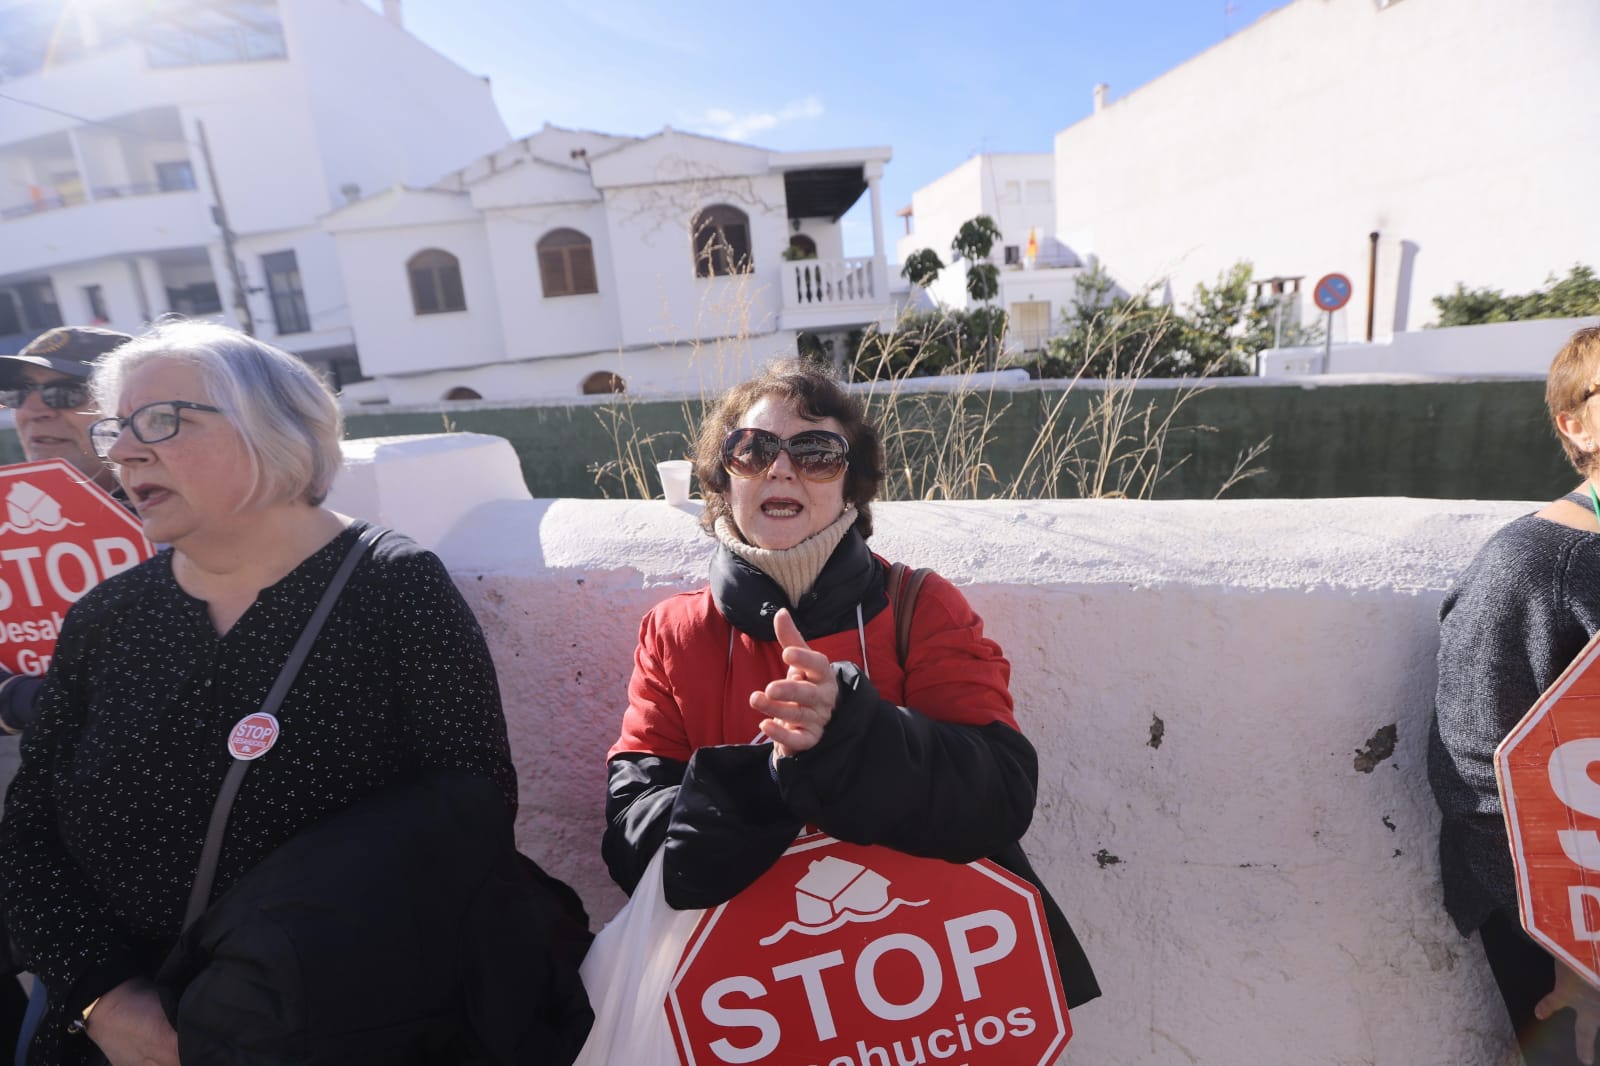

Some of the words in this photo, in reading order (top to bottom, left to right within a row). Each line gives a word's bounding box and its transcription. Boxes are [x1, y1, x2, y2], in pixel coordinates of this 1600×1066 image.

[236, 724, 273, 740] STOP
[701, 909, 1017, 1064] STOP
[807, 1006, 1037, 1066] hucios
